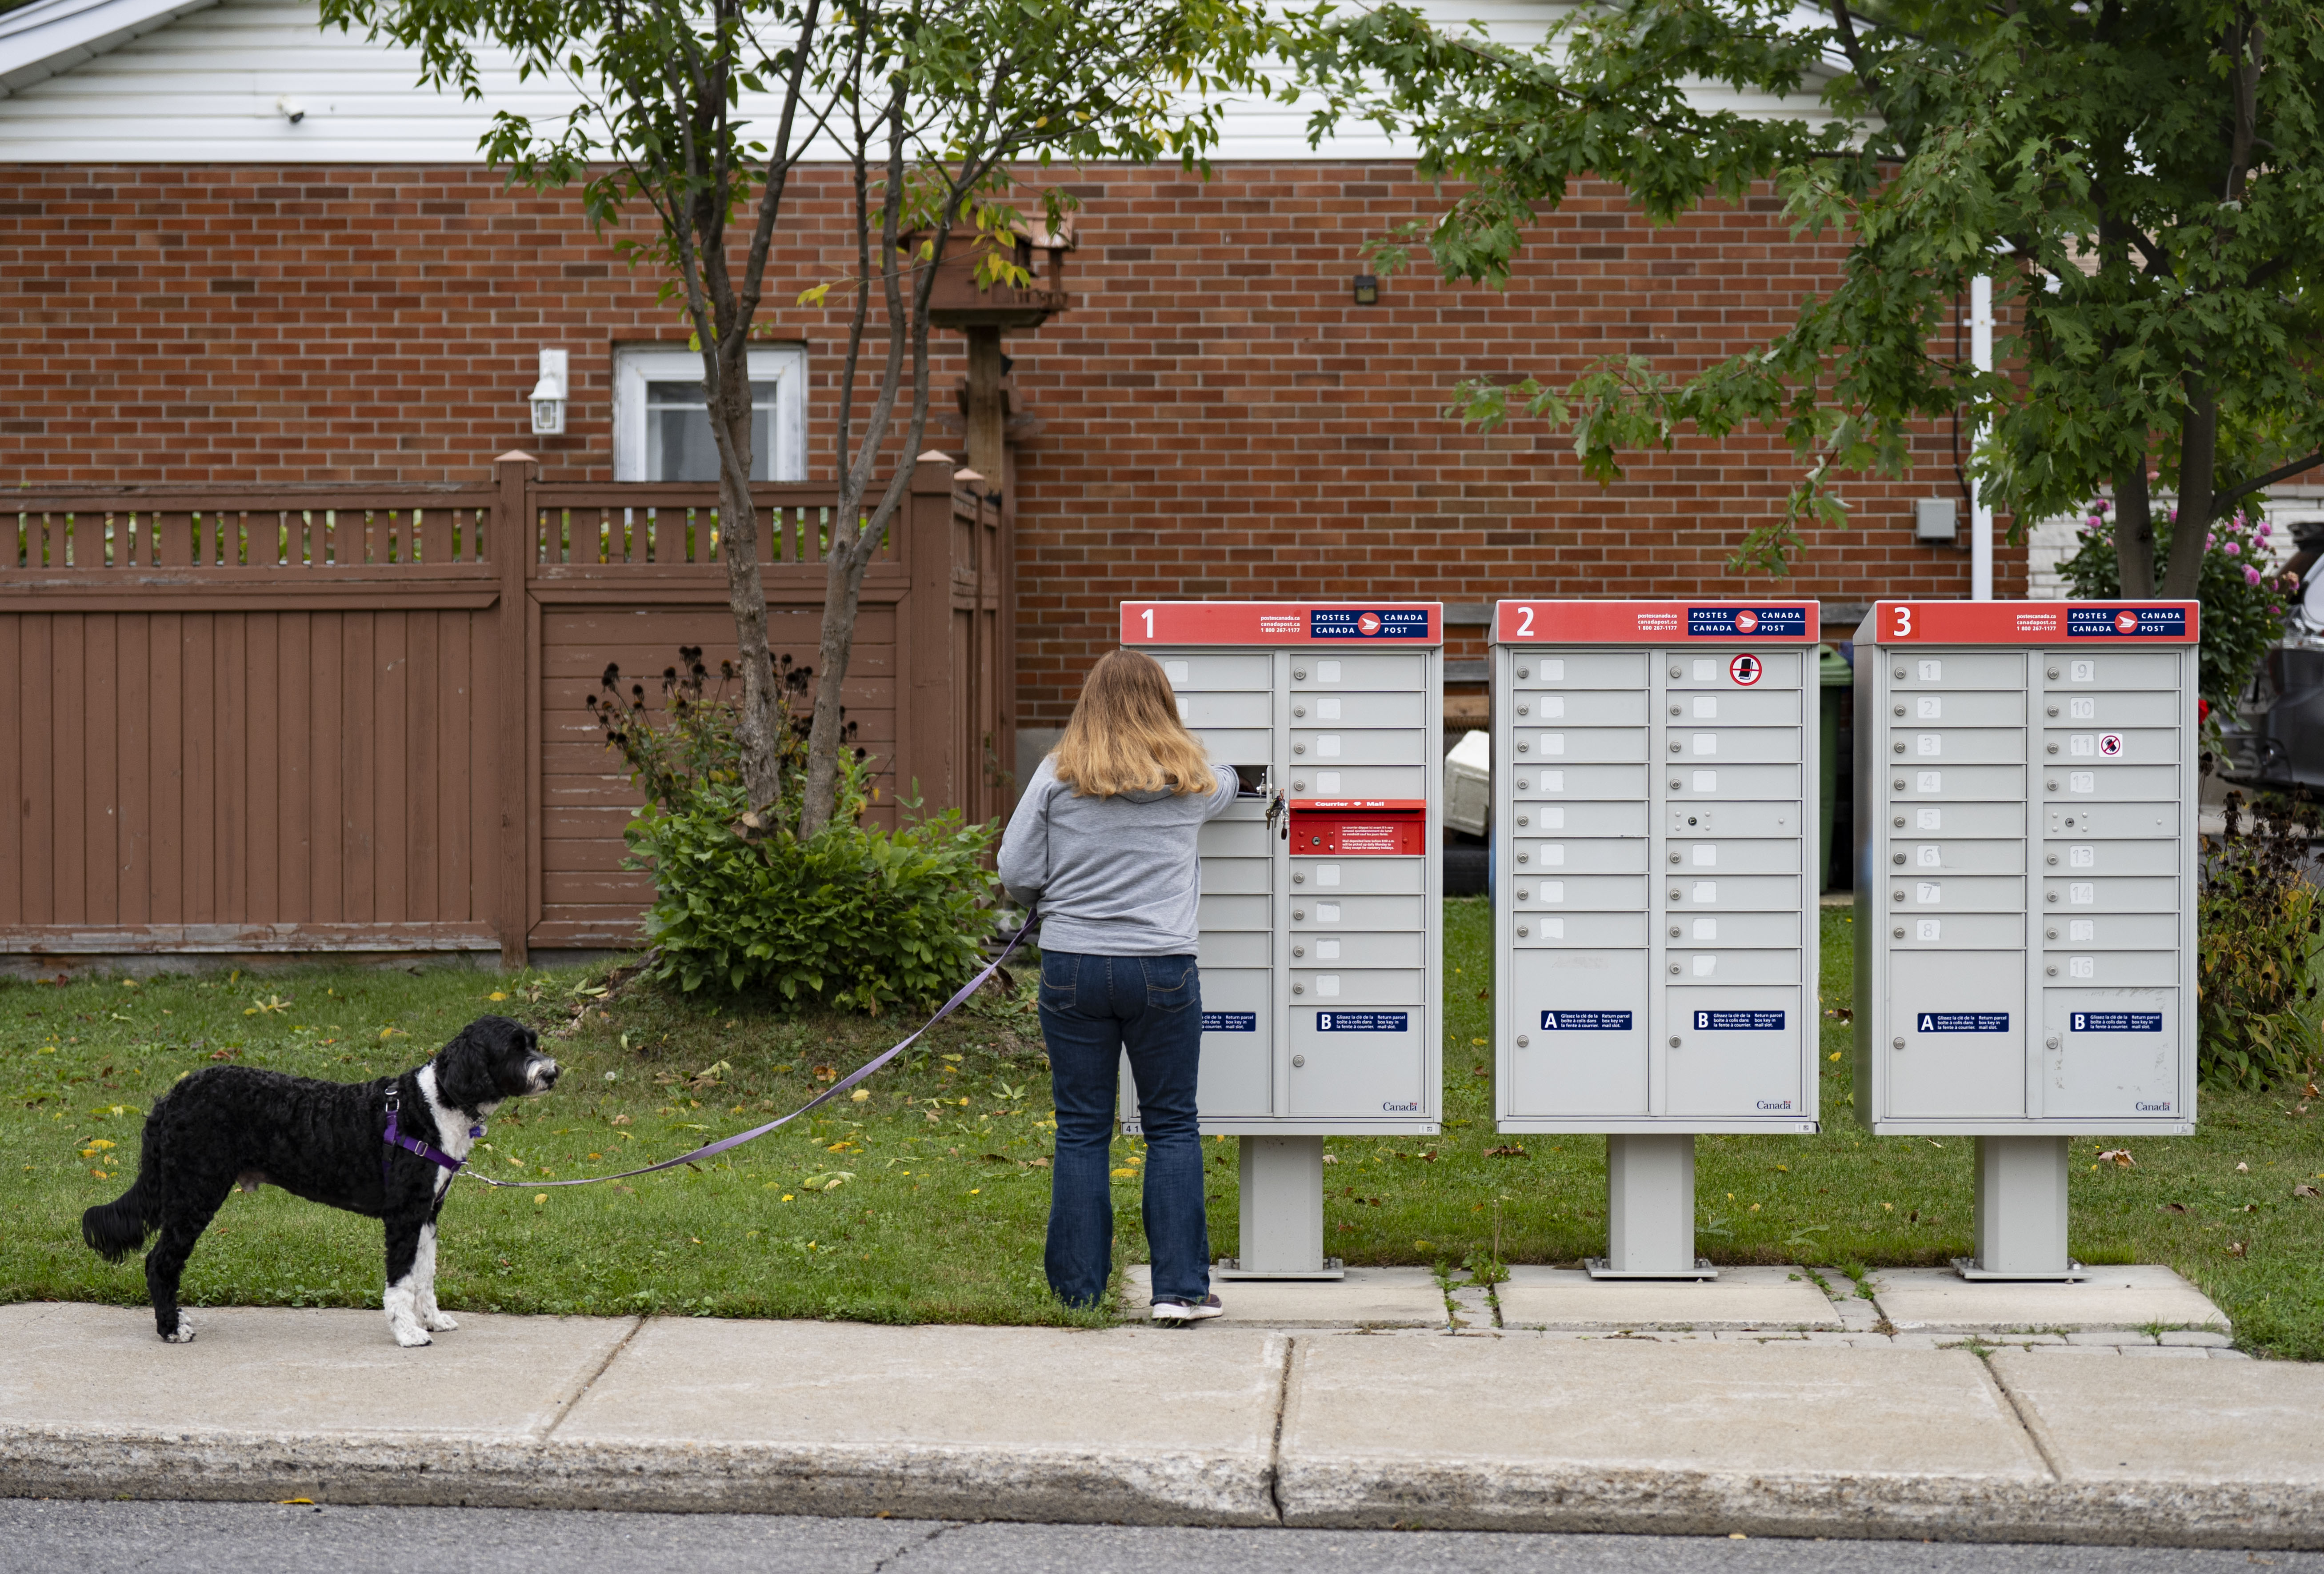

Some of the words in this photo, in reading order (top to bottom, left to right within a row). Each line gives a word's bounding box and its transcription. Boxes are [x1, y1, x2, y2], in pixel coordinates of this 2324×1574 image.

[1141, 609, 1153, 638] 1
[1517, 607, 1533, 635] 2
[1894, 607, 1911, 636] 3
[1925, 664, 1931, 678] 1
[2078, 664, 2087, 678] 9
[1924, 700, 1932, 715] 2
[2073, 701, 2091, 716] 10
[1924, 738, 1932, 751] 3
[2073, 738, 2090, 752] 11
[1924, 775, 1933, 788] 4
[2073, 775, 2091, 790] 12
[1924, 812, 1932, 826] 5
[1924, 849, 1932, 862] 6
[2073, 849, 2091, 863] 13
[1924, 886, 1932, 899] 7
[2073, 886, 2091, 900] 14
[1924, 923, 1932, 937] 8
[2073, 961, 2091, 975] 16
[1322, 1015, 1331, 1029] B
[1545, 1013, 1557, 1028] A
[1699, 1013, 1708, 1027] B
[1921, 1015, 1933, 1030] A
[2076, 1015, 2084, 1029] B
[1383, 1102, 1417, 1111] Canada
[1757, 1101, 1790, 1109] Canada
[2136, 1102, 2170, 1111] Canada
